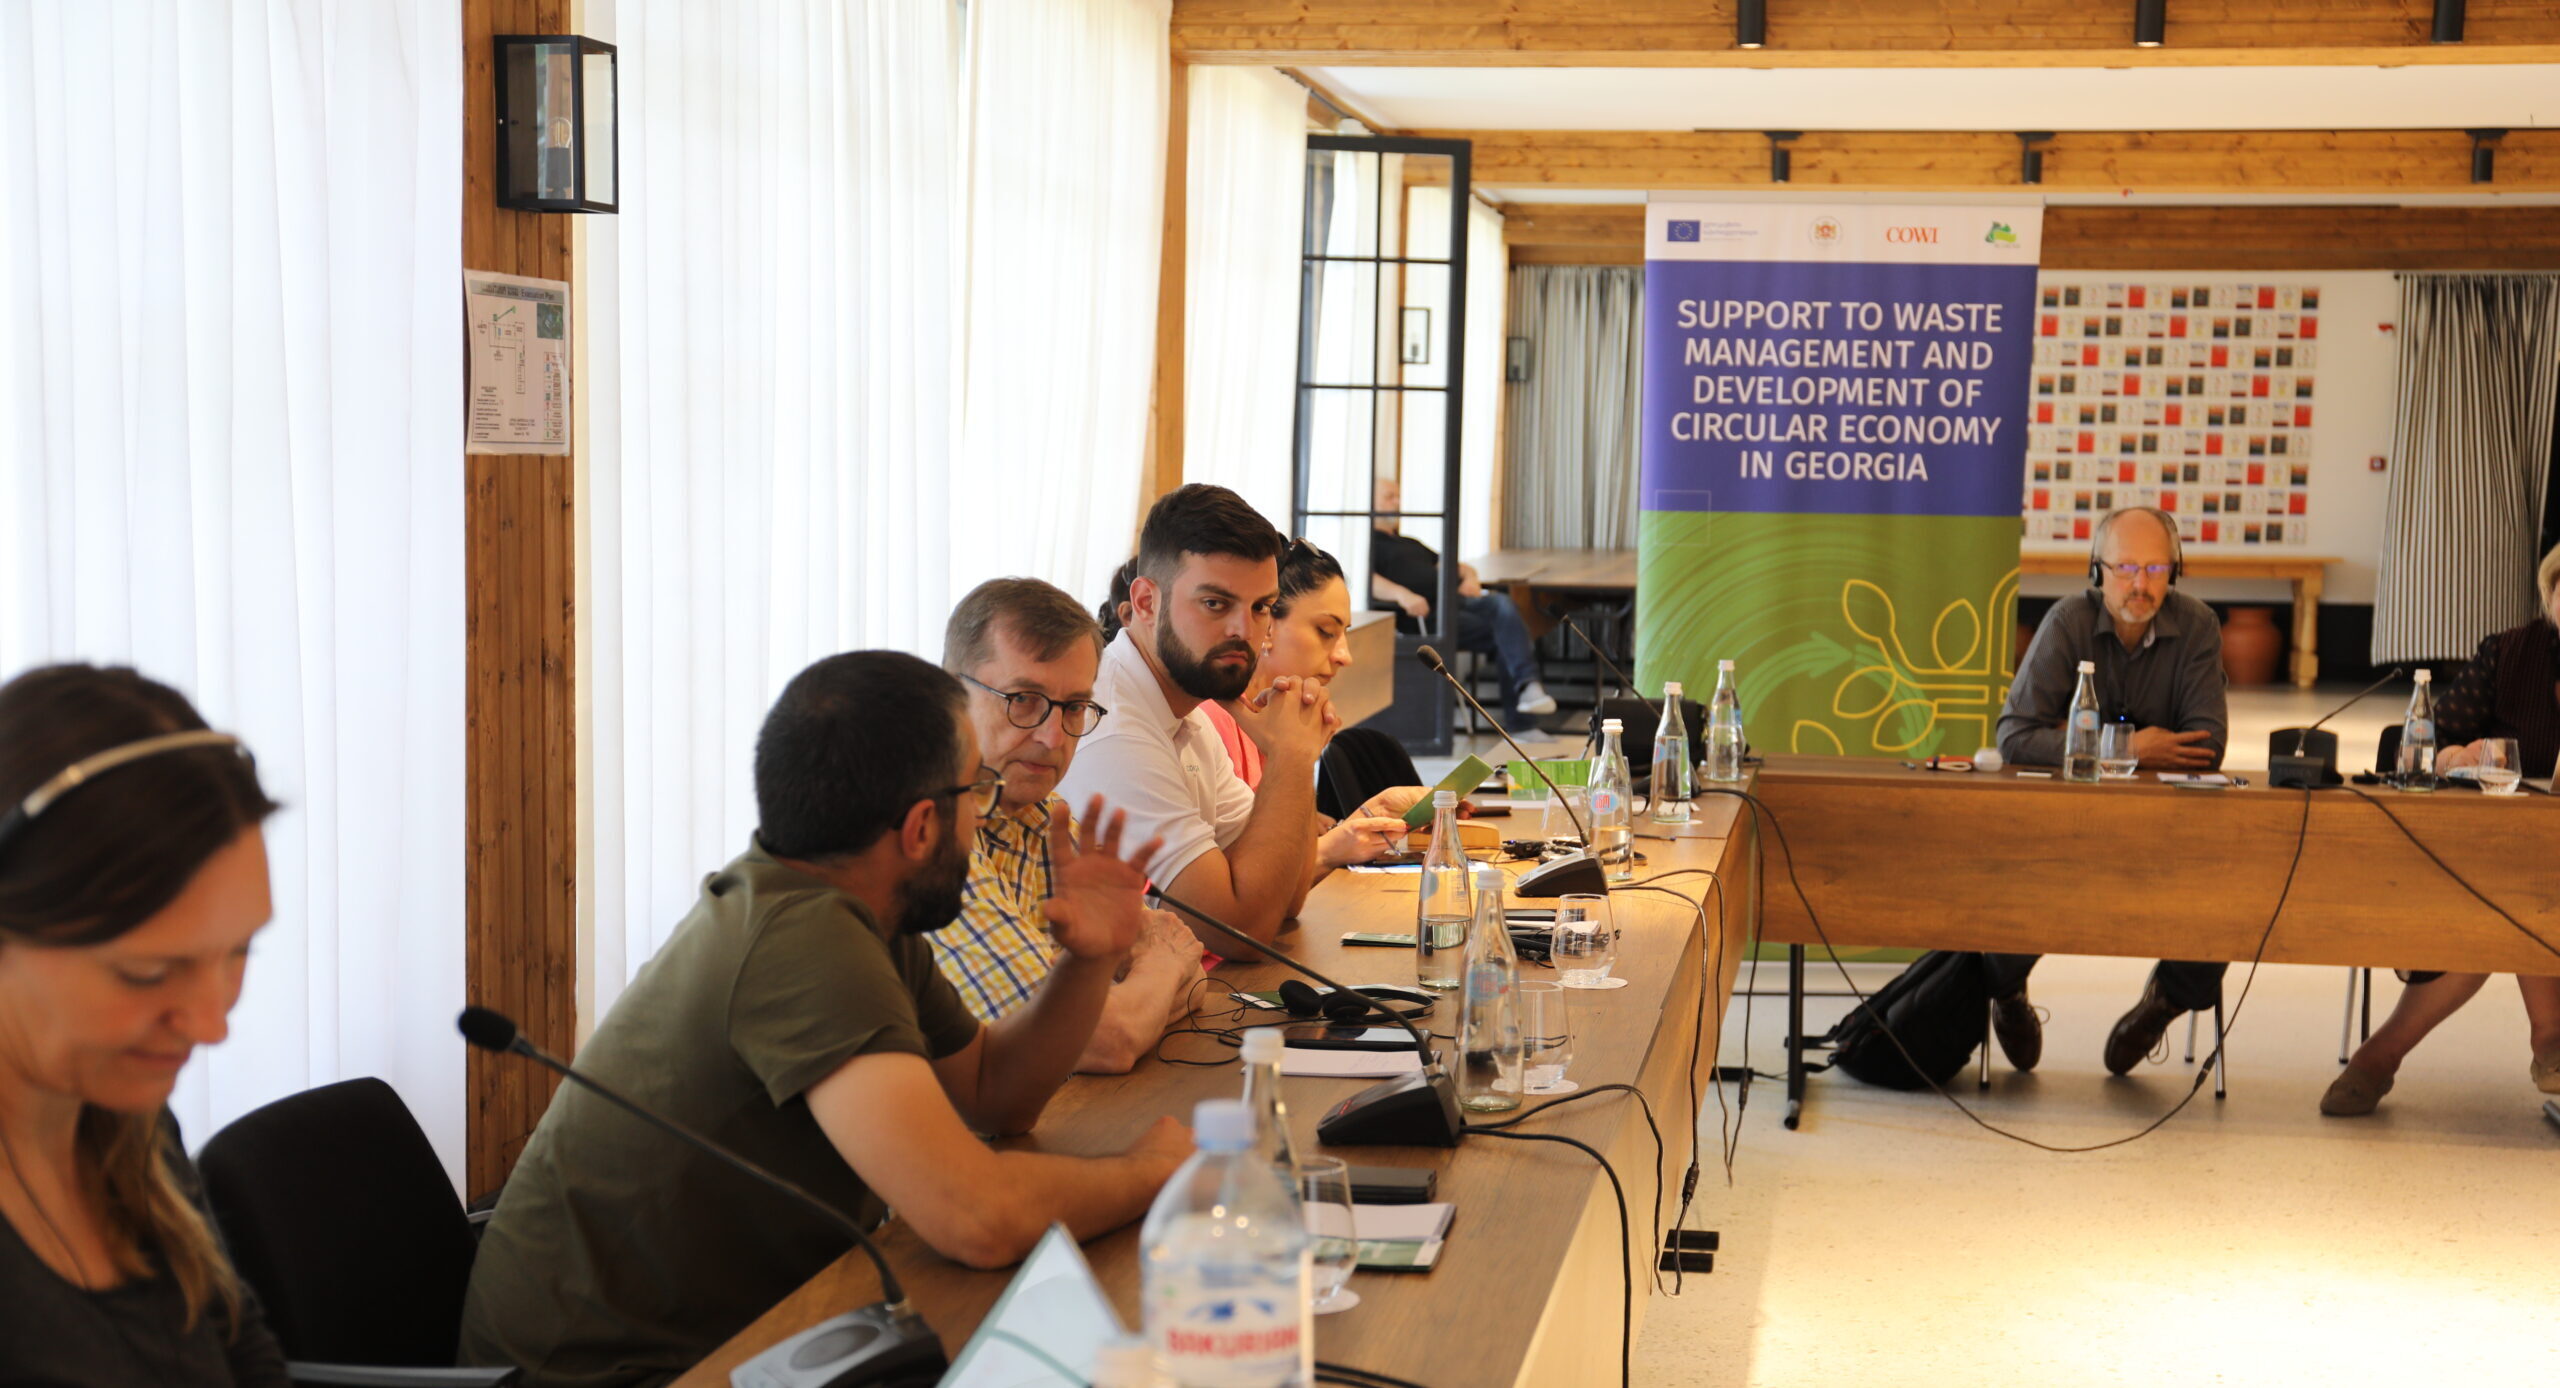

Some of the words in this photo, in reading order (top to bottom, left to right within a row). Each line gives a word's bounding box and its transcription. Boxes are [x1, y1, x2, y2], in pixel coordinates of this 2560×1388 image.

[1886, 226, 1937, 243] COWI
[1677, 299, 1831, 330] SUPPORT
[1840, 302, 1883, 331] TO
[1893, 303, 2003, 332] WASTE
[1684, 338, 1915, 369] MANAGEMENT
[1922, 341, 1994, 370] AND
[1693, 375, 1930, 407] DEVELOPMENT
[1939, 379, 1983, 408] OF
[1671, 412, 1828, 442] CIRCULAR
[1839, 414, 2002, 445] ECONOMY
[1740, 450, 1773, 479] IN
[1784, 451, 1929, 482] GEORGIA
